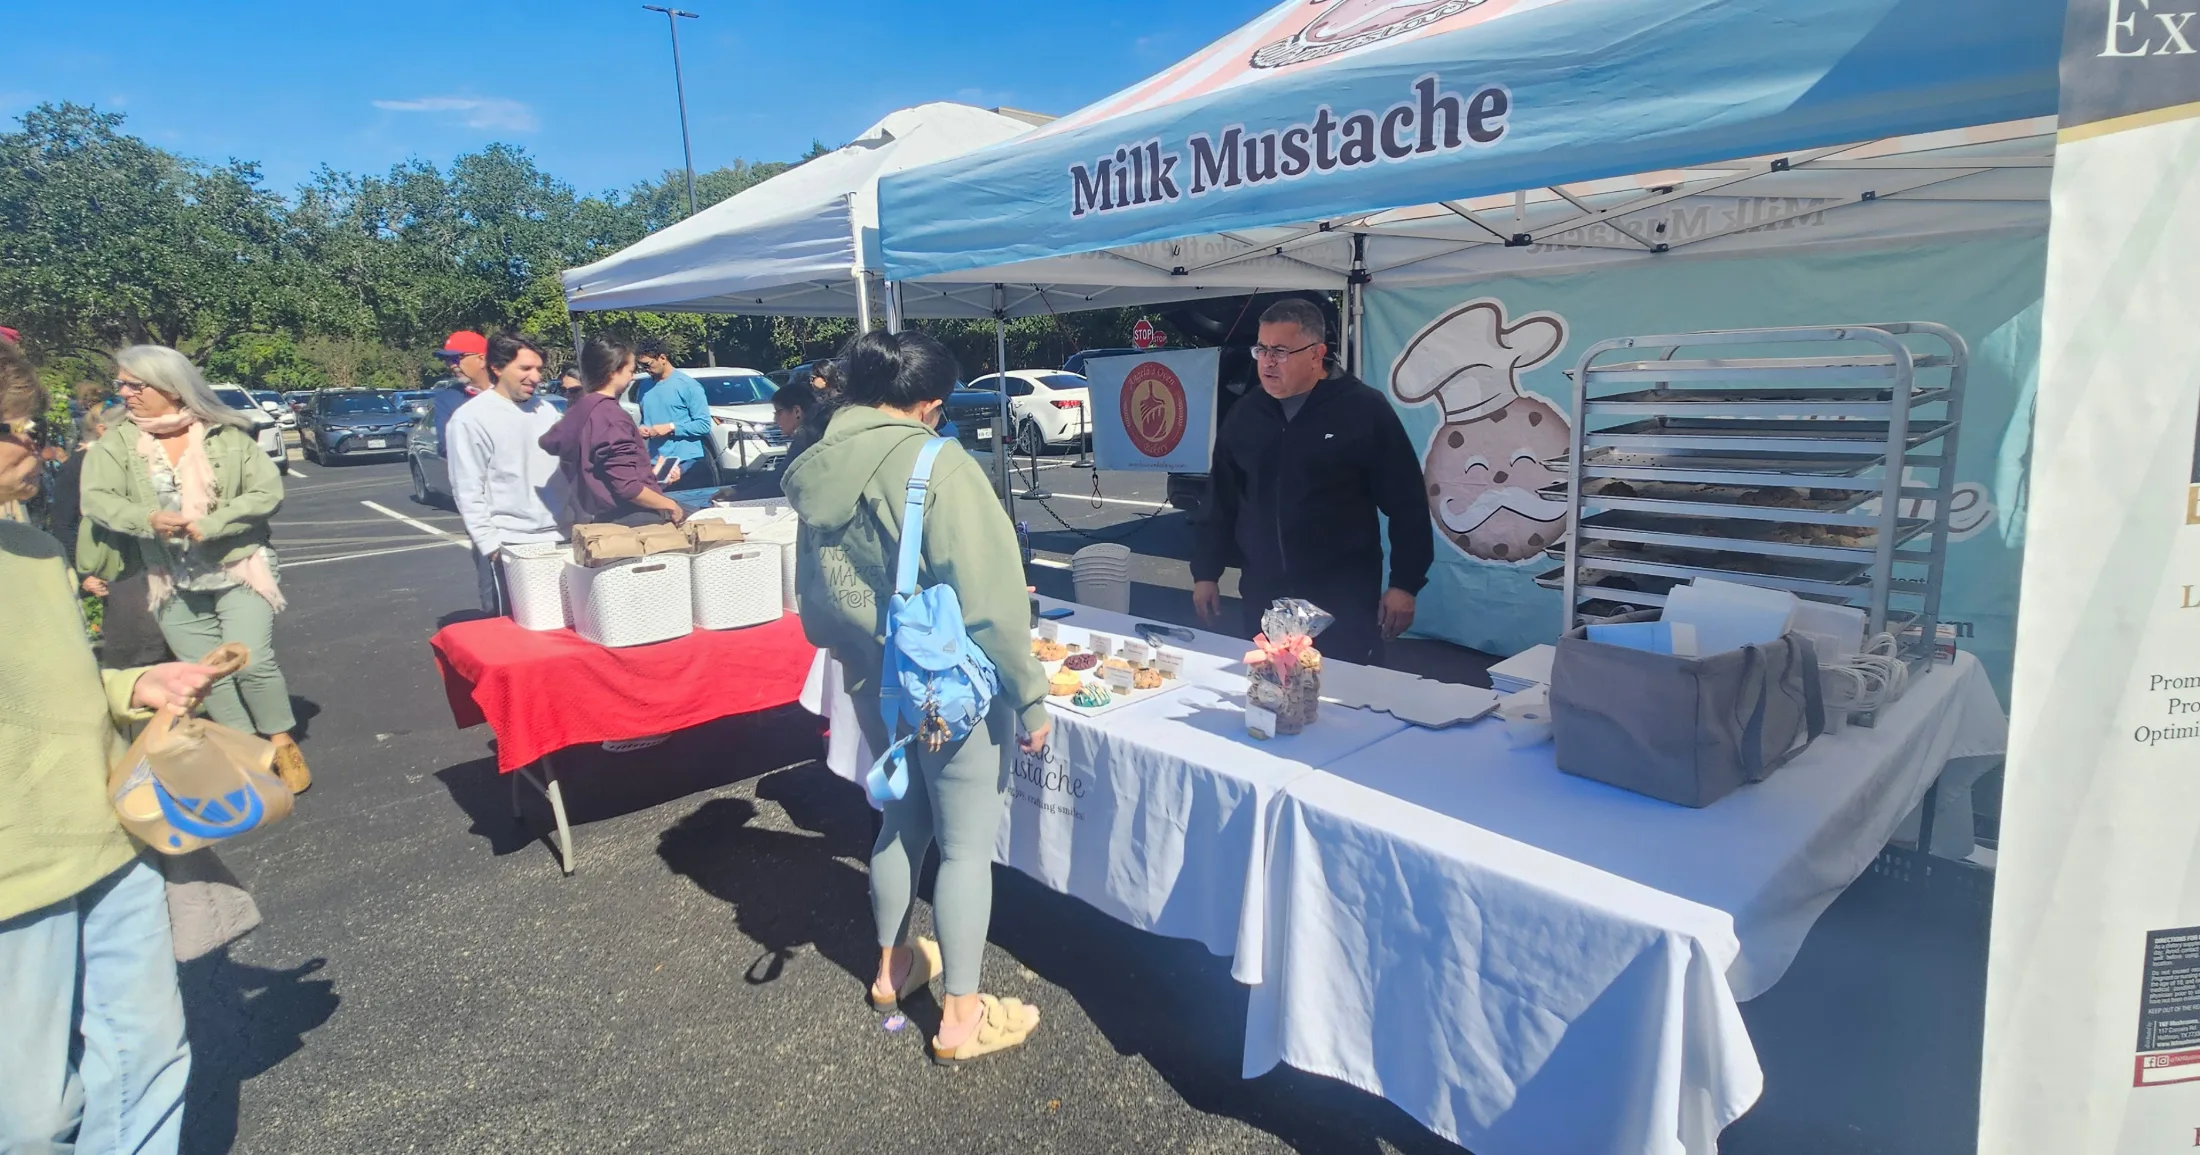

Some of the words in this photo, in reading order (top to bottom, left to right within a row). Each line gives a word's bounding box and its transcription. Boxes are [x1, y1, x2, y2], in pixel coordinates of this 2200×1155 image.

[1070, 141, 1180, 216] Milk
[1189, 77, 1509, 194] Mustache
[1134, 329, 1152, 341] STOP
[1153, 335, 1167, 343] STOP
[1009, 758, 1086, 799] ustache
